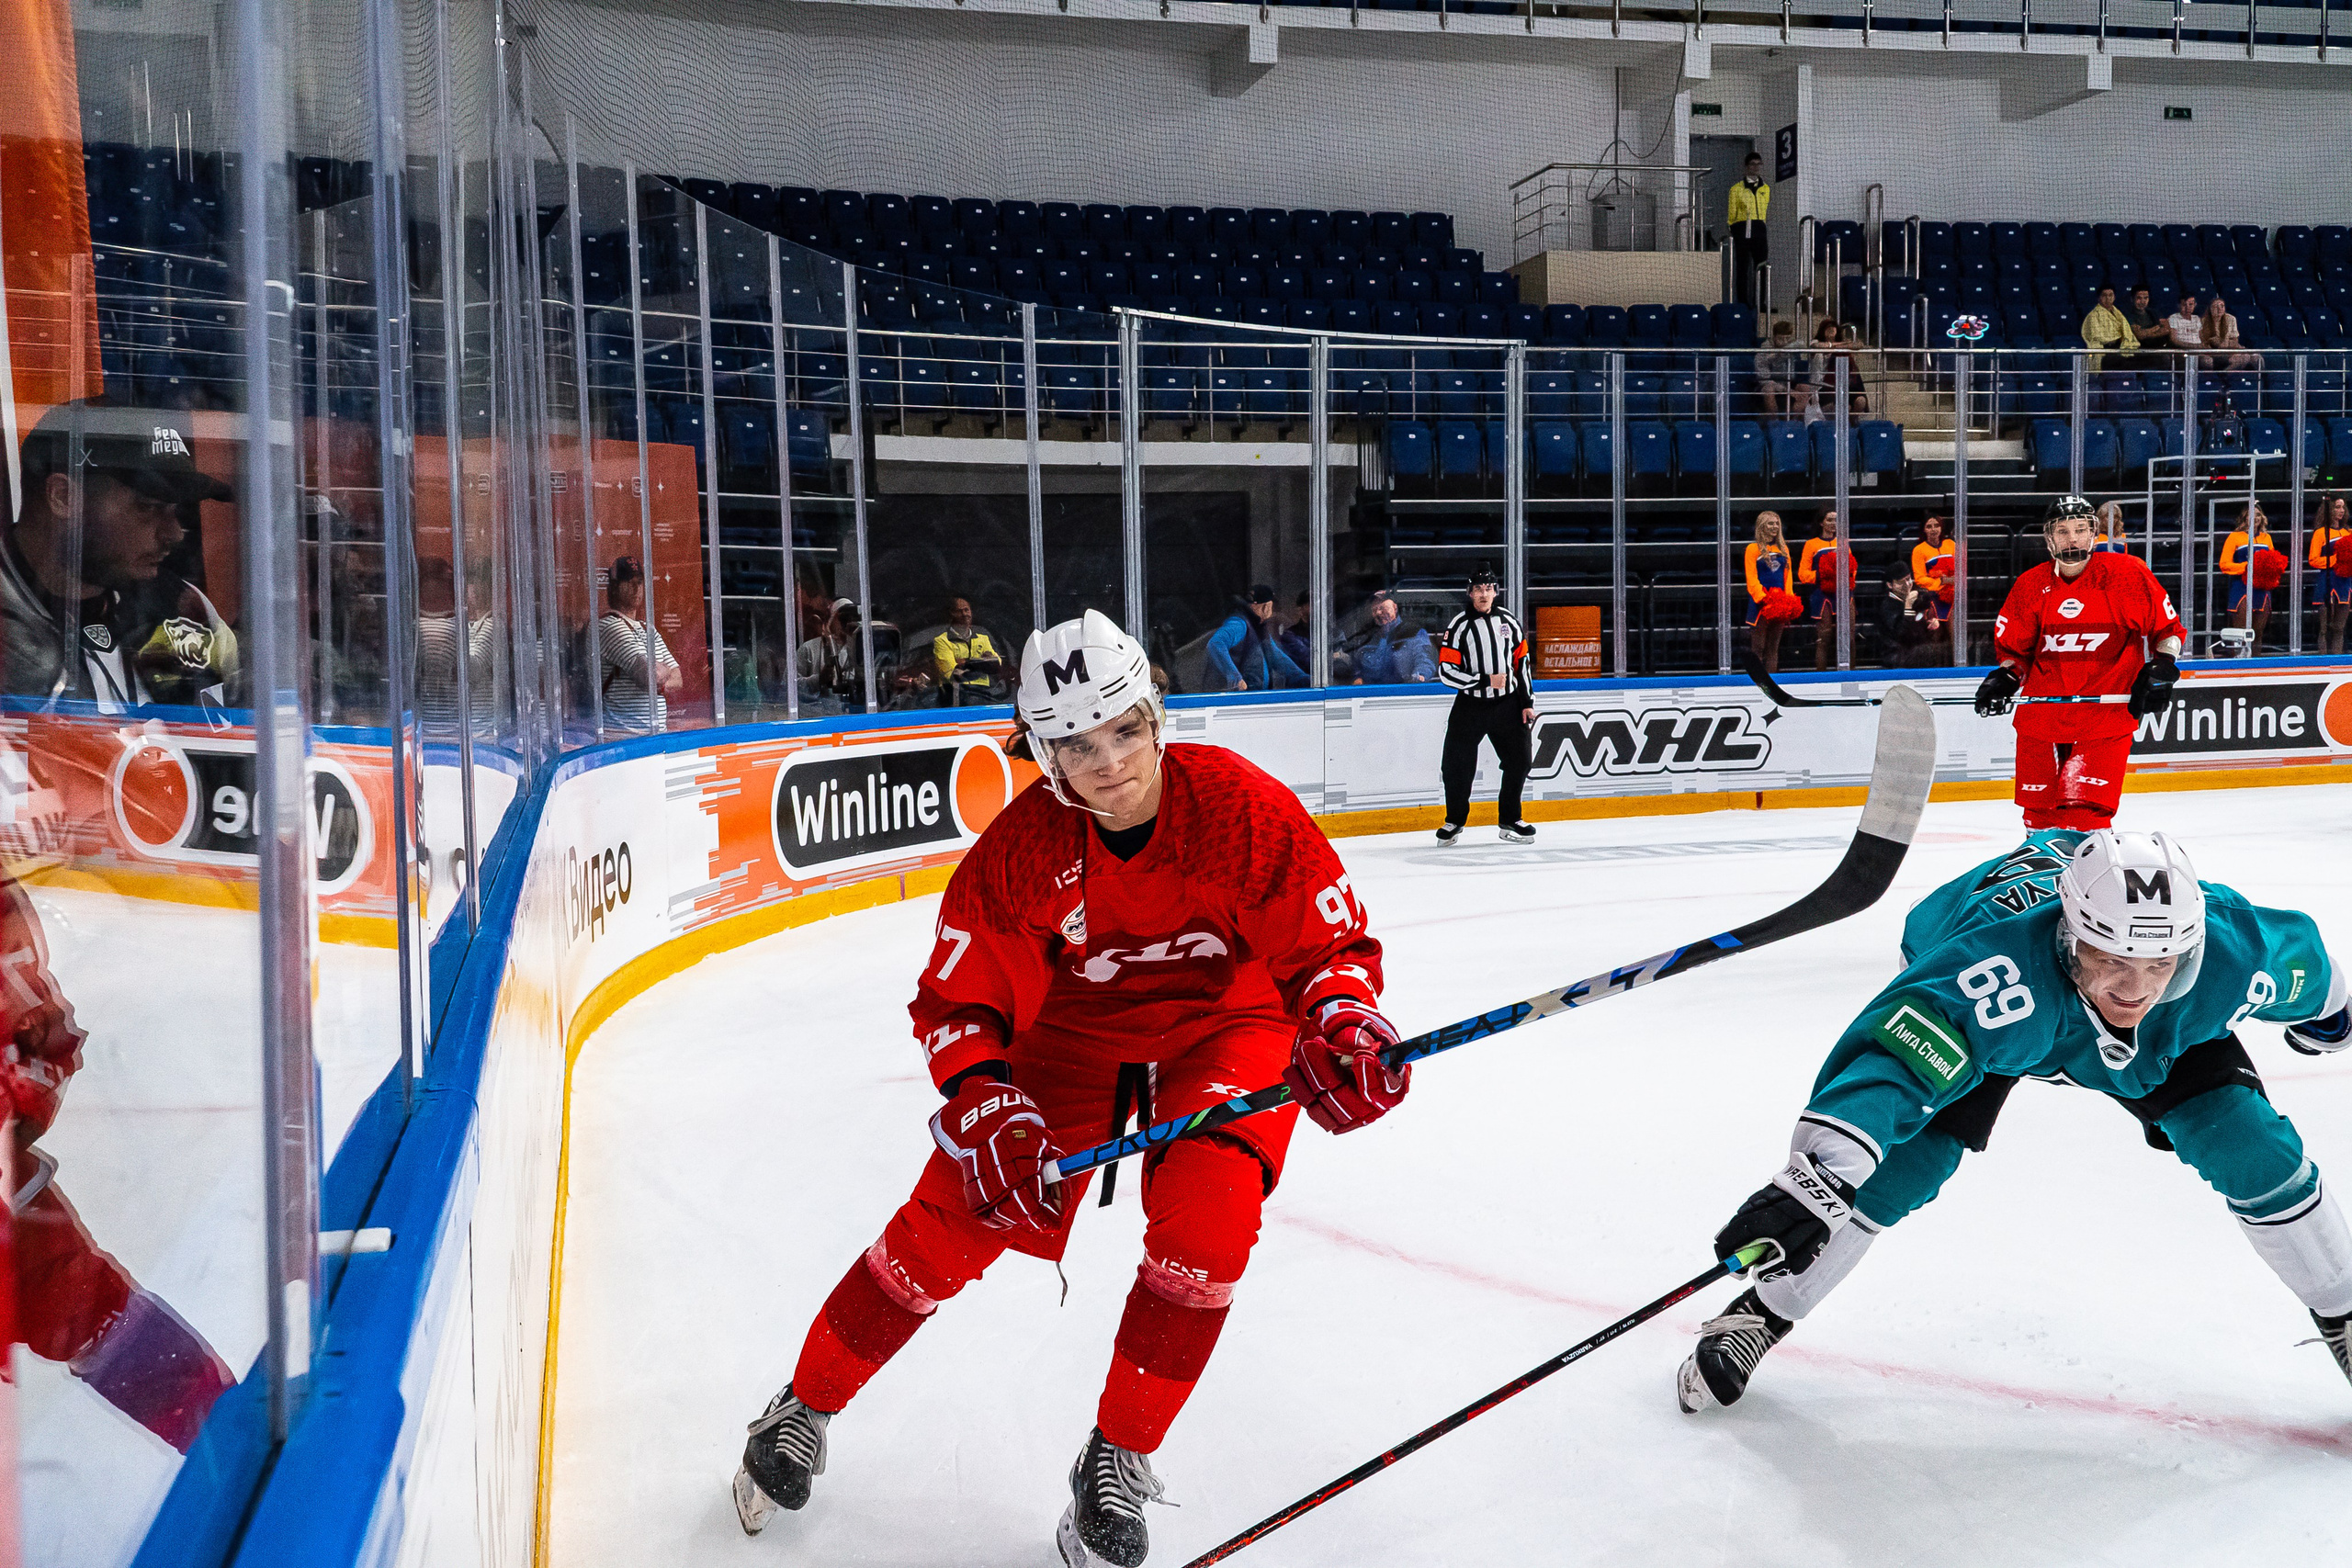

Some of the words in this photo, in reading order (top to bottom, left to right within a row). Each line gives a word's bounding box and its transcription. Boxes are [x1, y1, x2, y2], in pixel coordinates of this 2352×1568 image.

[1781, 130, 1792, 160] 3
[2041, 632, 2110, 653] X17
[1042, 649, 1091, 696] M
[1529, 714, 1769, 773] MHL
[2133, 696, 2306, 743] Winline
[790, 772, 941, 847] Winline
[569, 840, 632, 943] Видео
[2122, 868, 2172, 906] M
[1957, 954, 2036, 1031] 69
[1891, 1022, 1921, 1050] ЛИГА
[1917, 1041, 1953, 1078] СТАВОК
